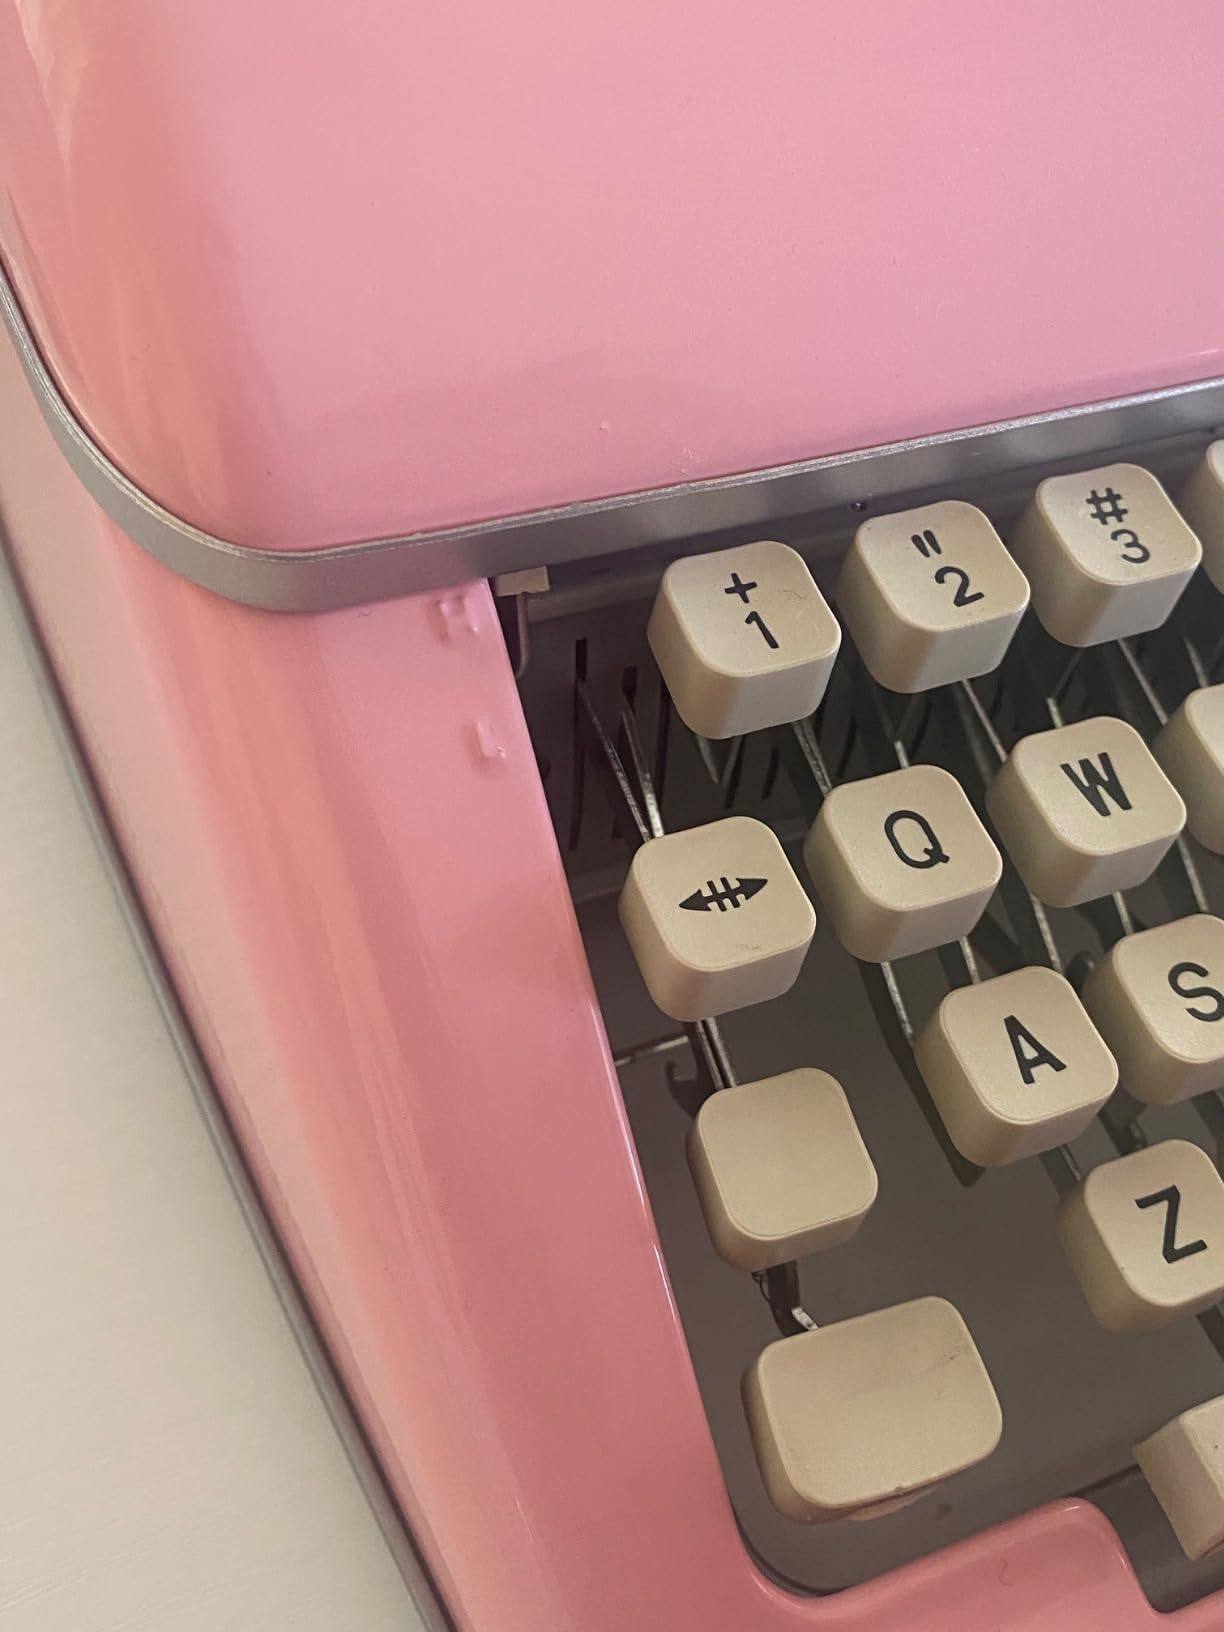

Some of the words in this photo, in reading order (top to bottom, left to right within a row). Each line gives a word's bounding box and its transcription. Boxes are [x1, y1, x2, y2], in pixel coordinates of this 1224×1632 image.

[1086, 488, 1128, 525] #
[1111, 529, 1150, 563] 3
[725, 573, 757, 603] +
[935, 567, 984, 607] 2
[745, 611, 778, 649] 1
[1061, 752, 1132, 816] W
[884, 810, 949, 869] Q
[1168, 962, 1224, 1022] S
[1004, 1015, 1066, 1084] A
[1135, 1185, 1207, 1263] Z
